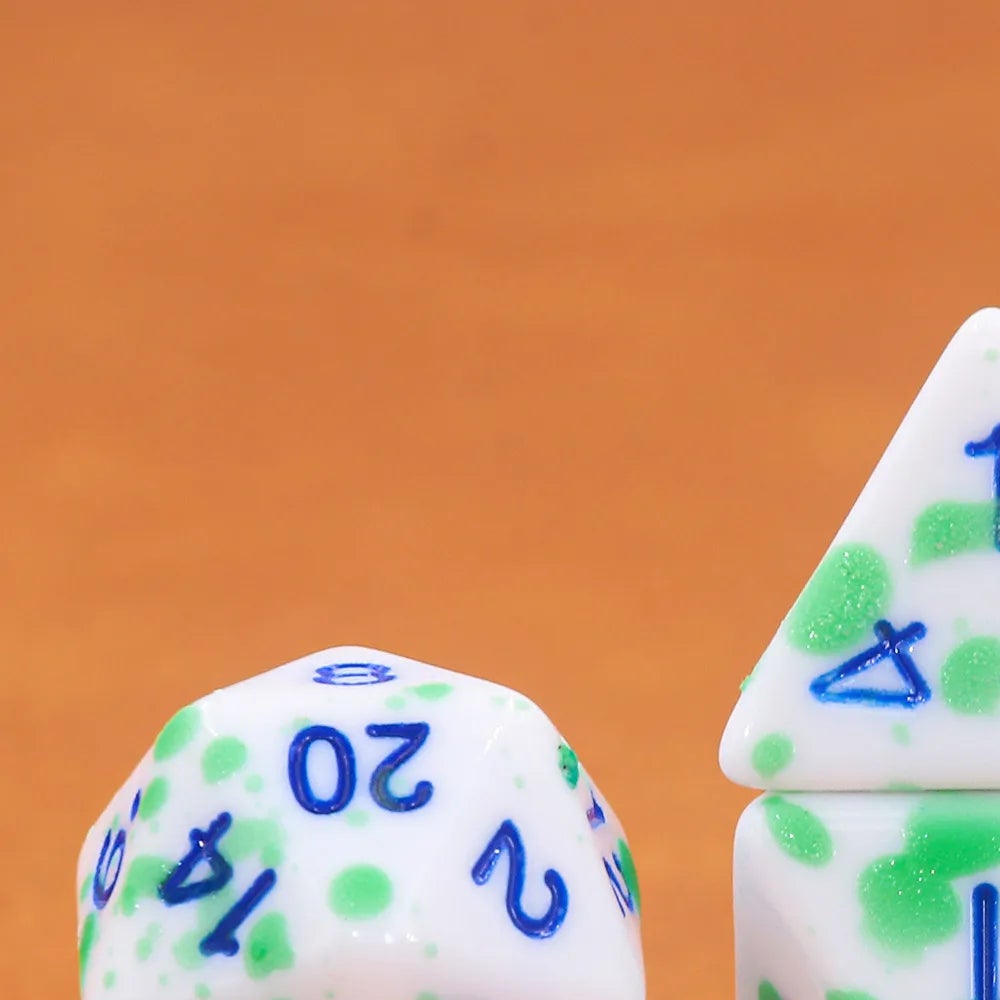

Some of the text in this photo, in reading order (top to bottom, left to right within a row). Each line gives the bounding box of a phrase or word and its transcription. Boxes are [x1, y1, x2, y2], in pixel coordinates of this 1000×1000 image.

[808, 619, 933, 708] 4
[286, 722, 435, 817] 20
[158, 811, 279, 958] 14
[470, 818, 569, 941] 2
